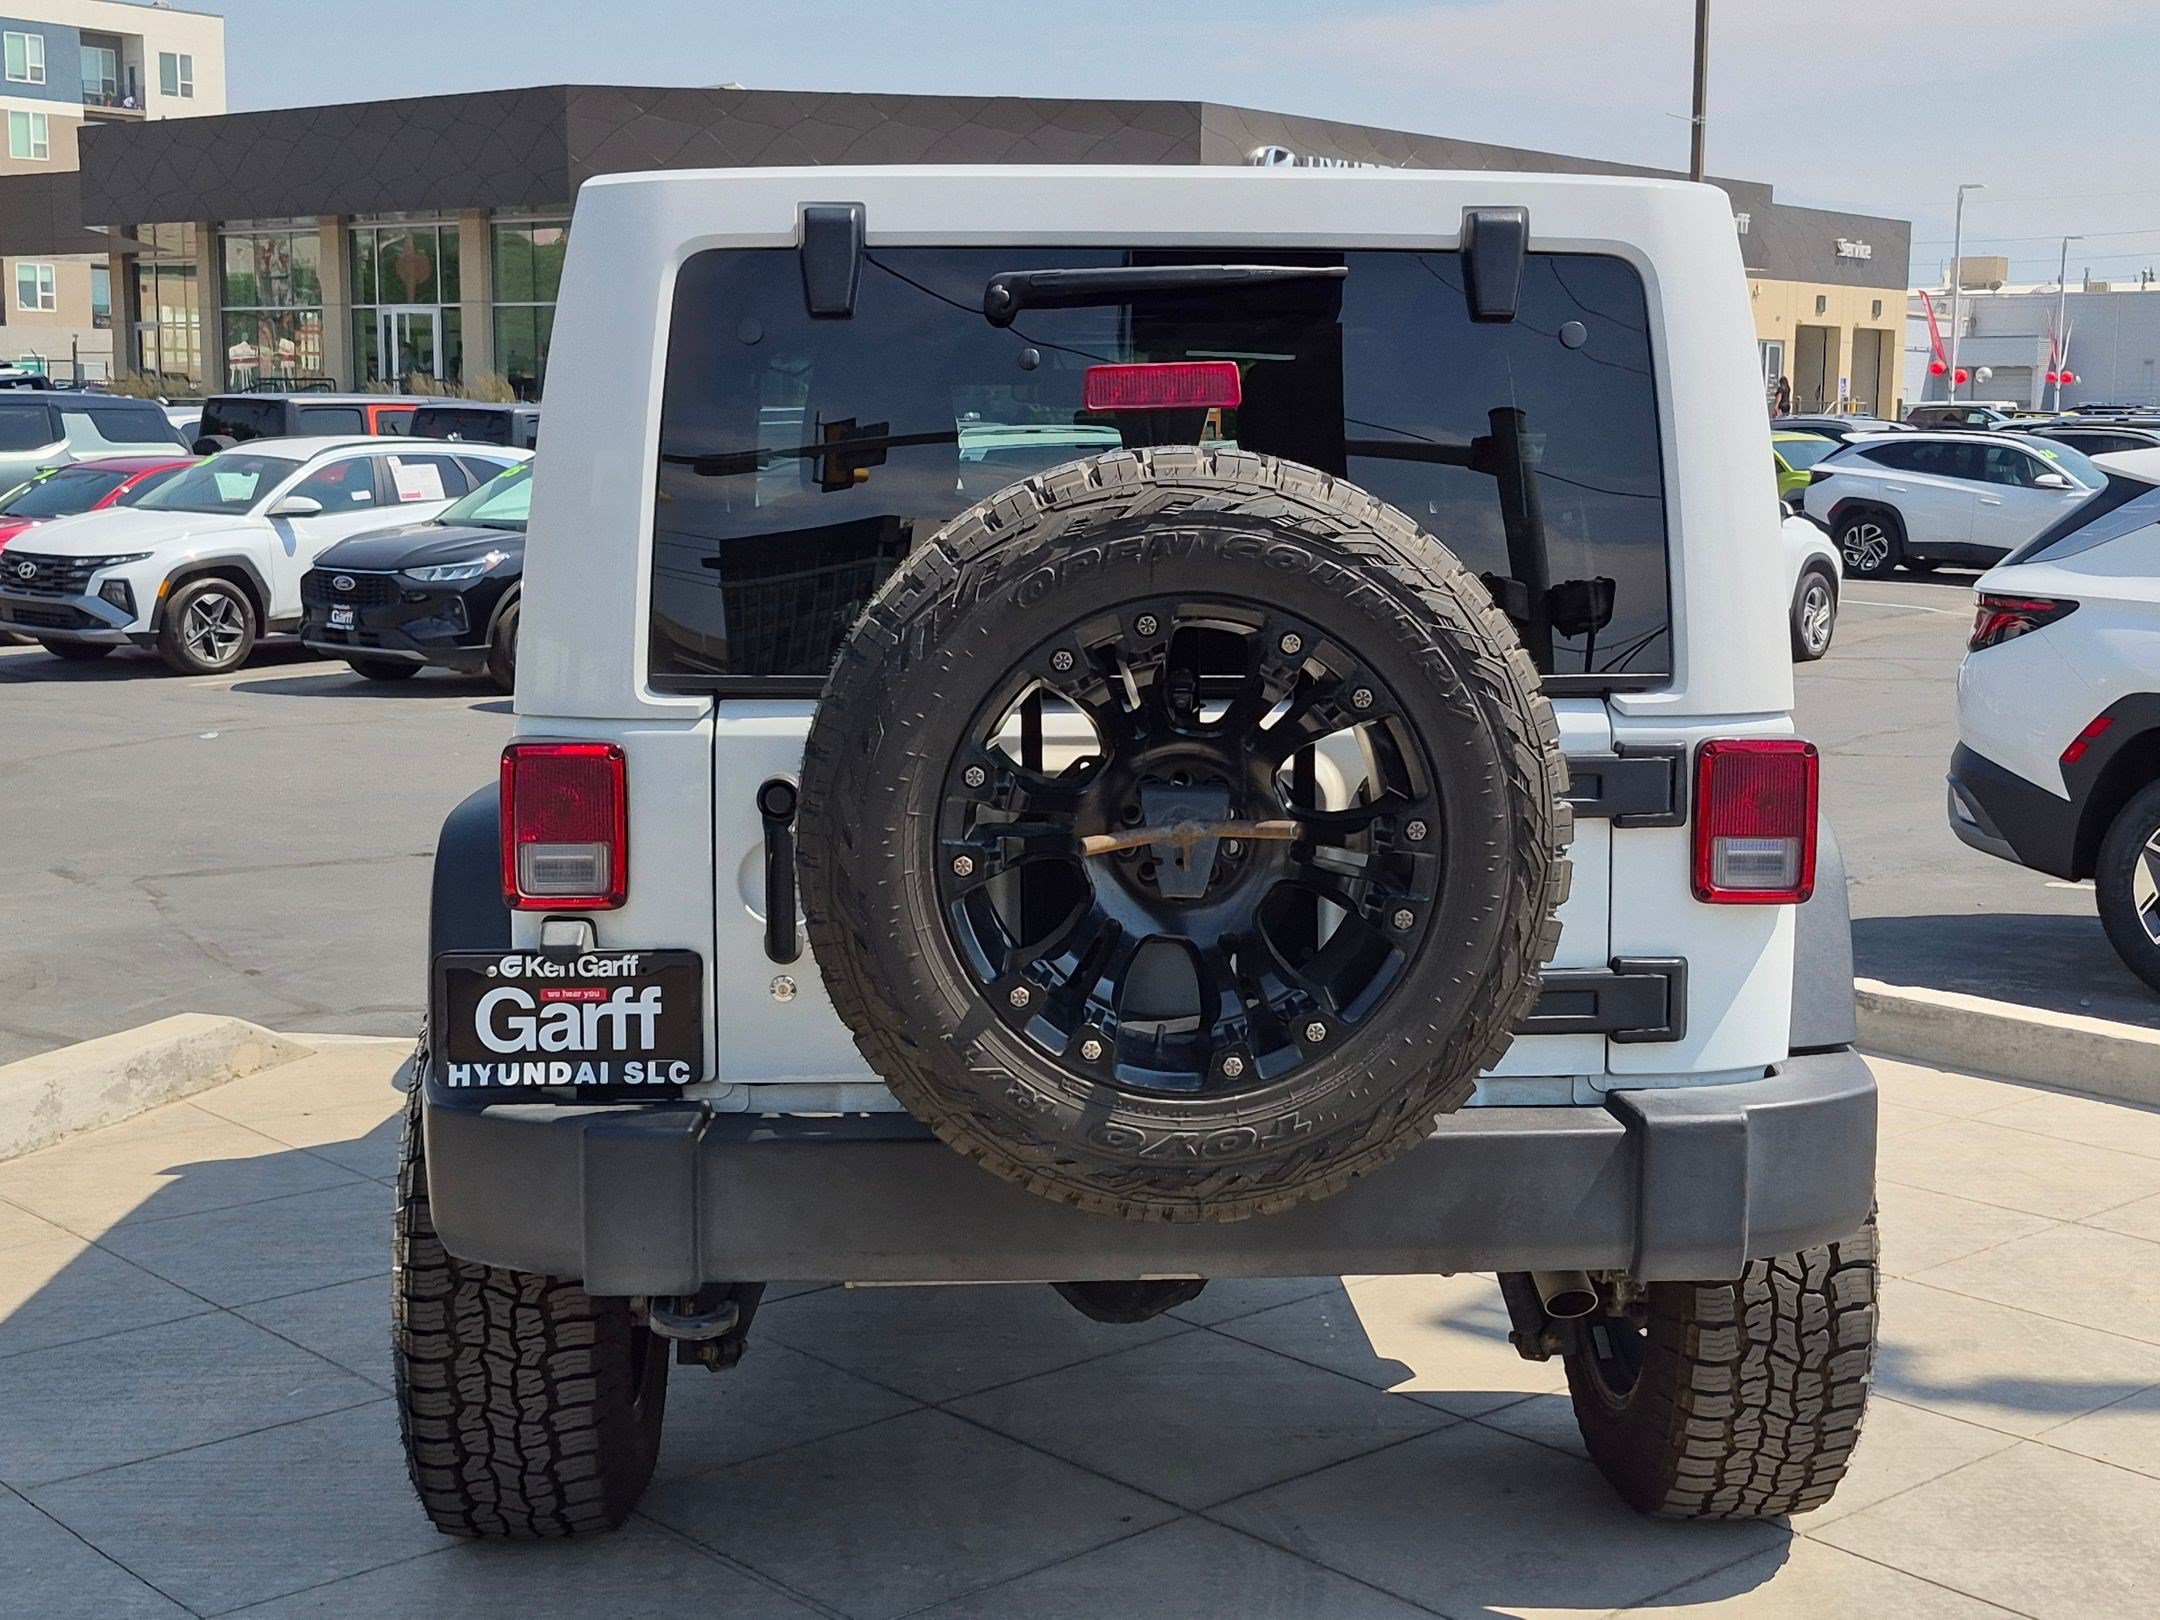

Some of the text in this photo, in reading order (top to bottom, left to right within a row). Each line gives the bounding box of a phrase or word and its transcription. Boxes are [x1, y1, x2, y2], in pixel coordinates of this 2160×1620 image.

[1835, 238, 1872, 260] Service
[1009, 532, 1480, 723] OPEN COUNTRY
[576, 954, 639, 978] Garff
[562, 990, 581, 998] hear
[583, 990, 601, 1000] you
[475, 986, 662, 1053] Garff
[447, 1061, 691, 1088] HYUNDAI SLC
[1088, 1111, 1314, 1159] TOYO
